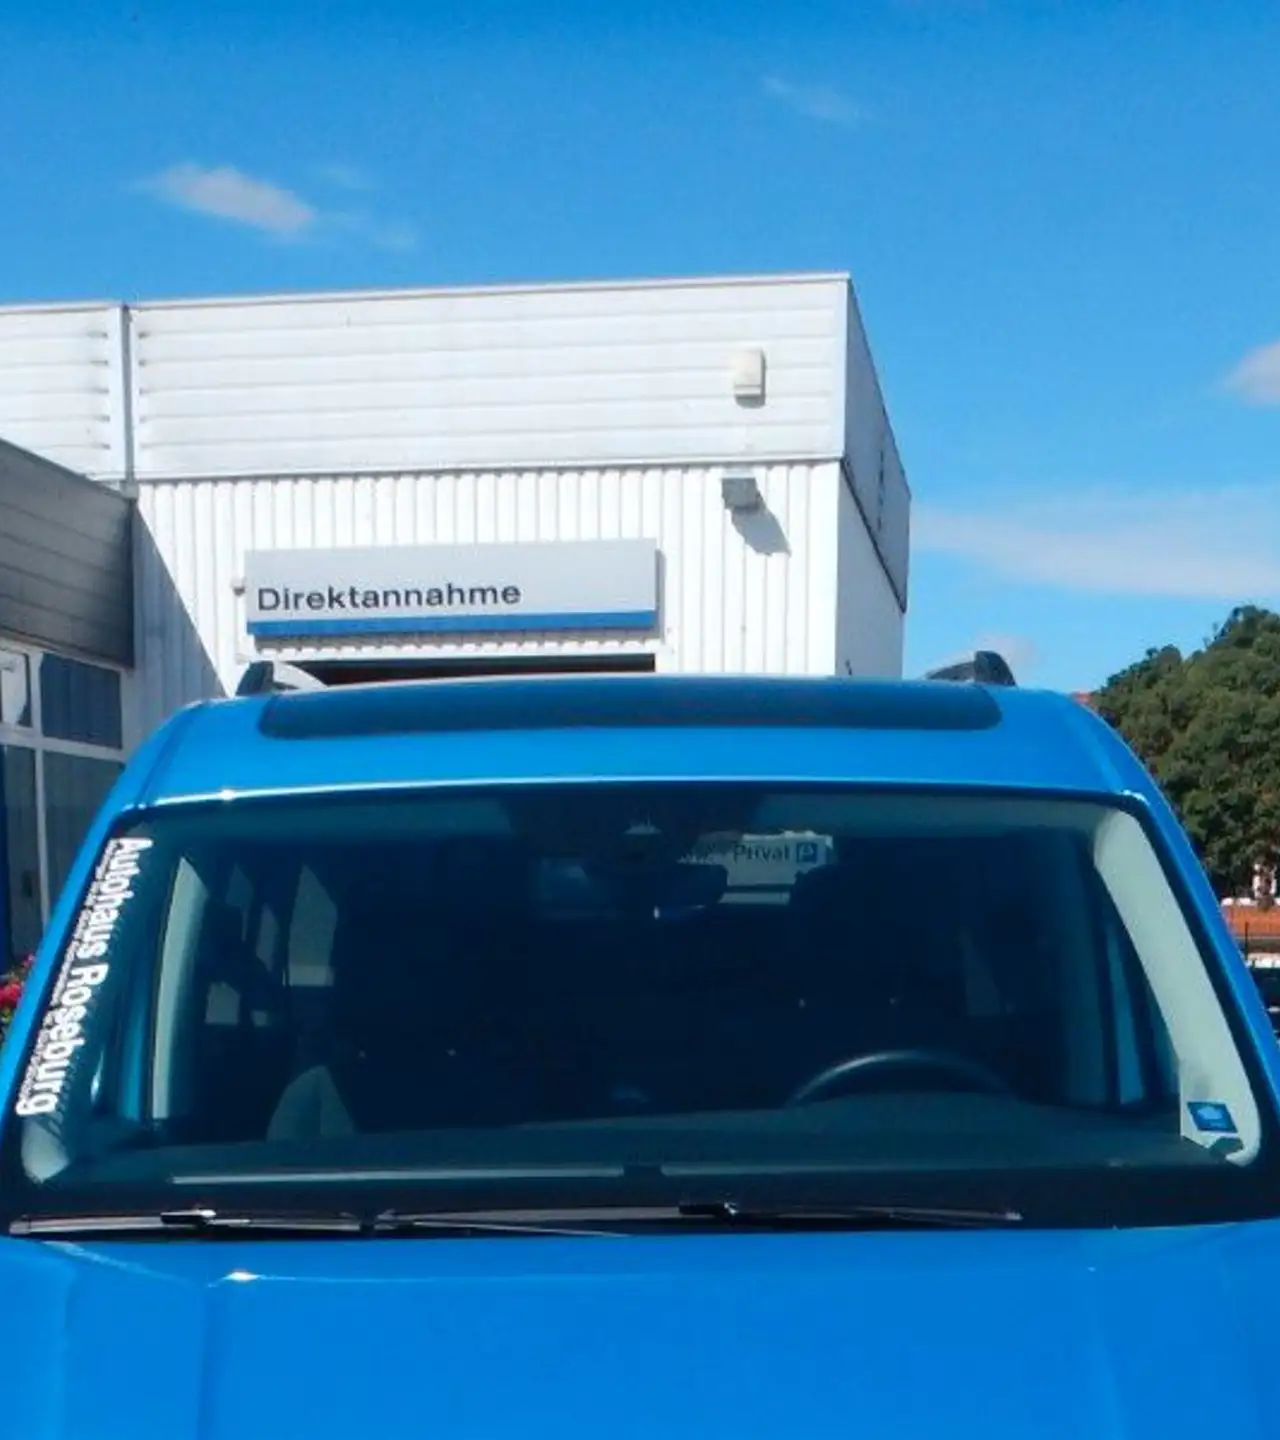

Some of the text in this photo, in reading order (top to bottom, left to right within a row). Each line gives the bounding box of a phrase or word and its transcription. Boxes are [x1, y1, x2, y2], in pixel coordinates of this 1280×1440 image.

[258, 582, 522, 612] Direktannahme
[77, 837, 154, 960] Autohaus
[15, 963, 109, 1116] Roseburg
